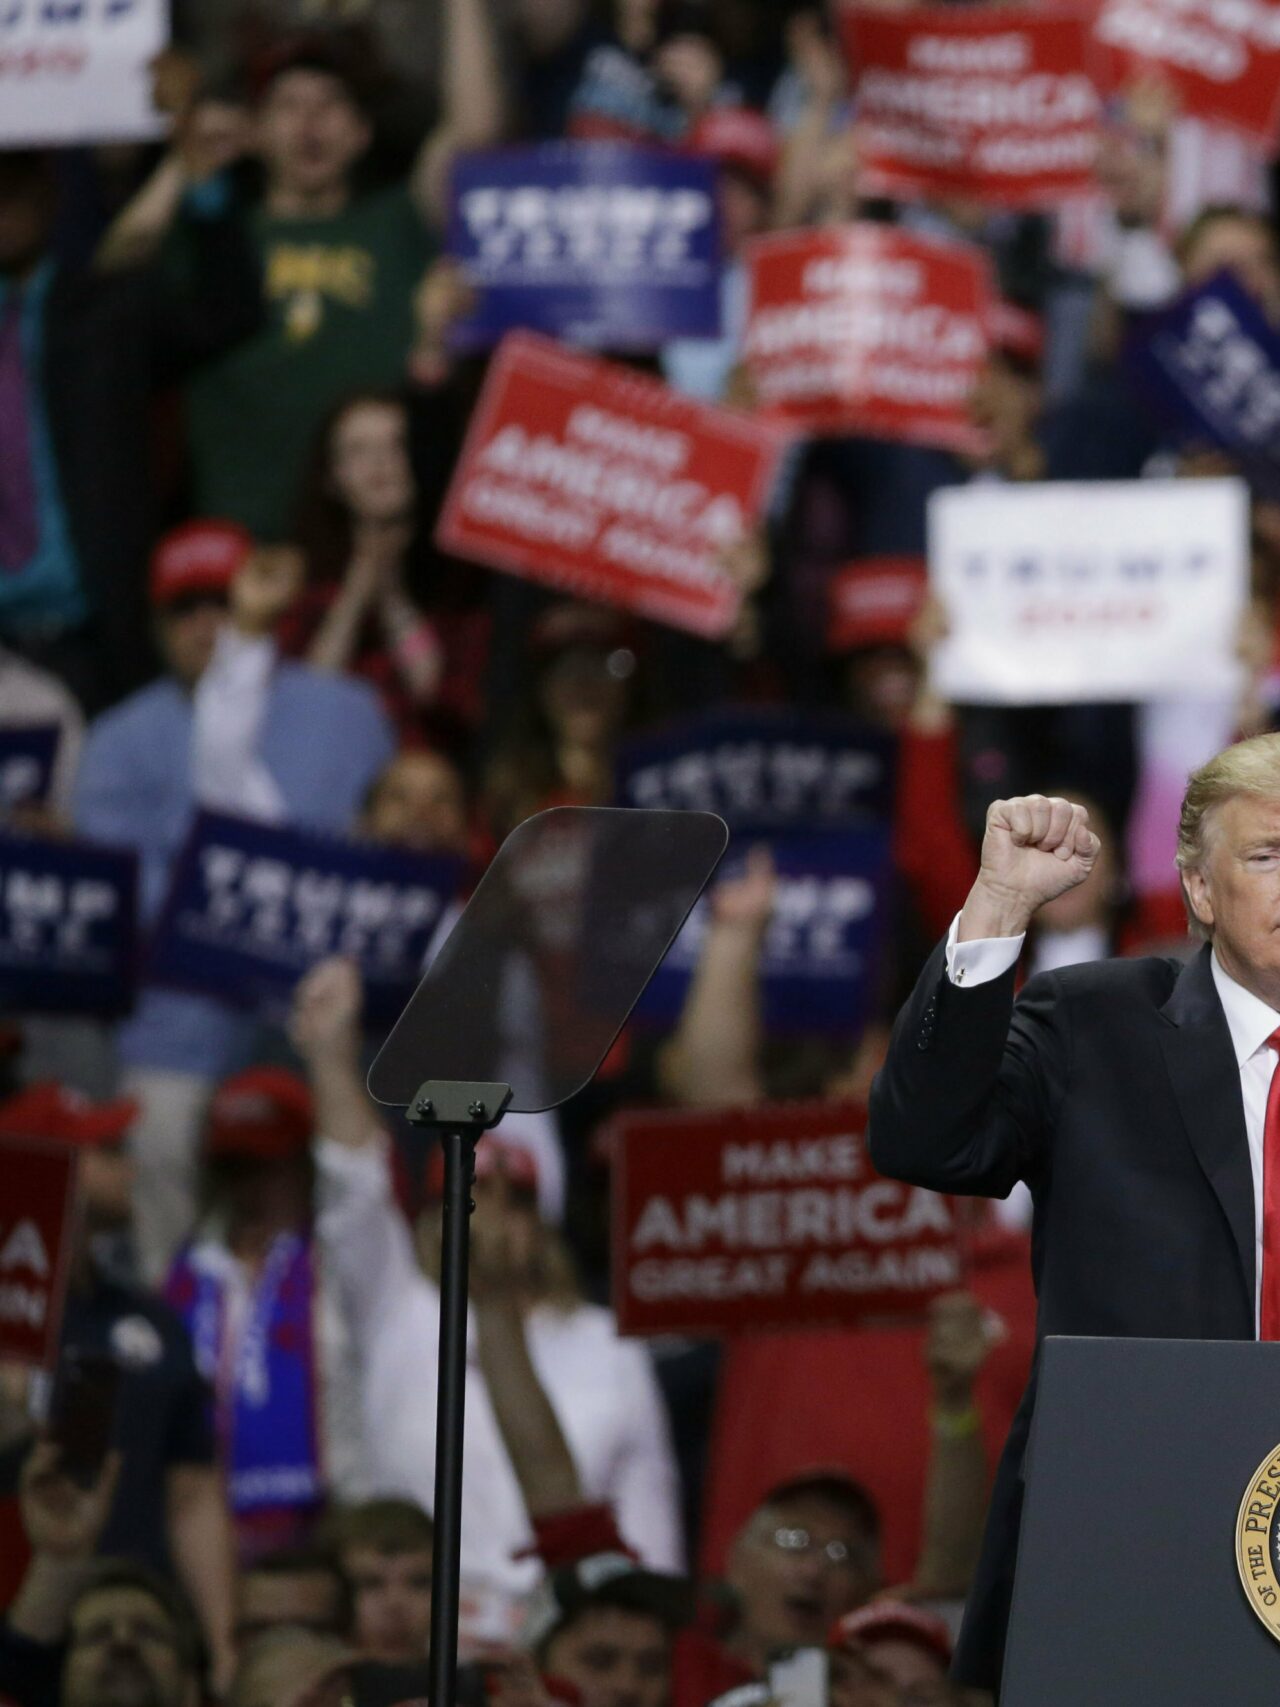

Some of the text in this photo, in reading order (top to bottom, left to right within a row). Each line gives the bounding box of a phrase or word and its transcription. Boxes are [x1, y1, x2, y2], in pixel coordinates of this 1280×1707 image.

[463, 187, 709, 232] TRUMP
[483, 428, 741, 546] AMERICA
[963, 549, 1213, 587] TRUMP
[202, 845, 440, 926] TRUMP
[722, 1135, 864, 1183] MAKE
[631, 1184, 952, 1250] AMERICA
[629, 1255, 788, 1302] GREAT
[1248, 1544, 1267, 1581] THE
[1257, 1585, 1277, 1606] OF
